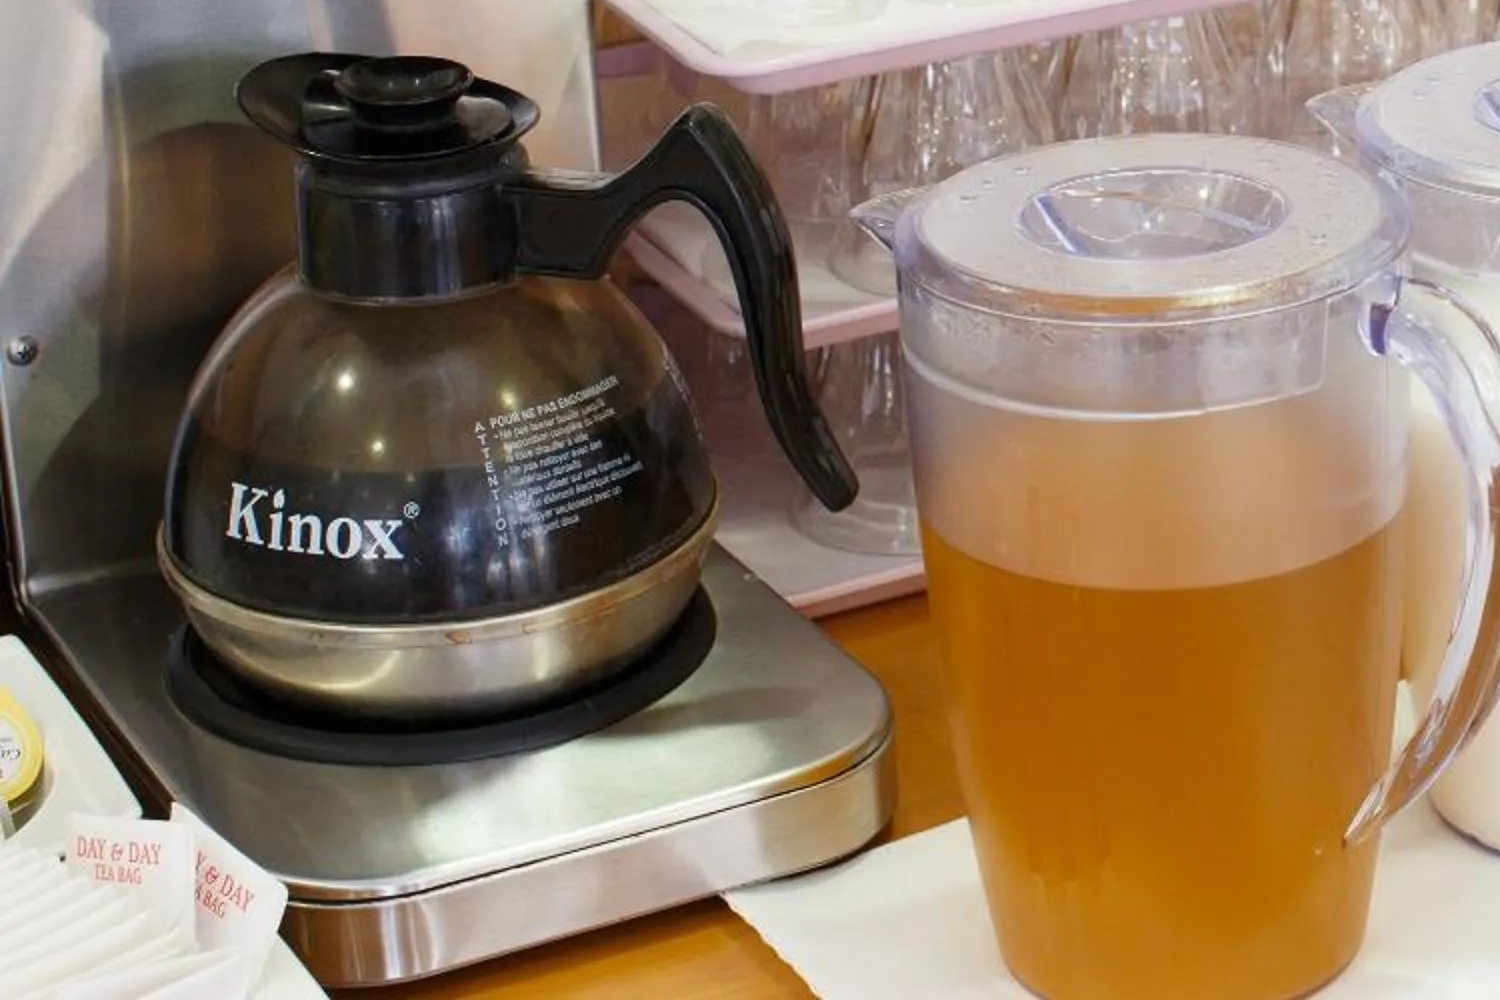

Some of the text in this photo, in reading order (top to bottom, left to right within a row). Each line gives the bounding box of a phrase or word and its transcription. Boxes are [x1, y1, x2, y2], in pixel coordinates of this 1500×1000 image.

[77, 836, 161, 864] DAY & DAY
[94, 863, 142, 885] TEA BAG
[203, 890, 225, 918] BAG
[221, 874, 255, 911] DAY
